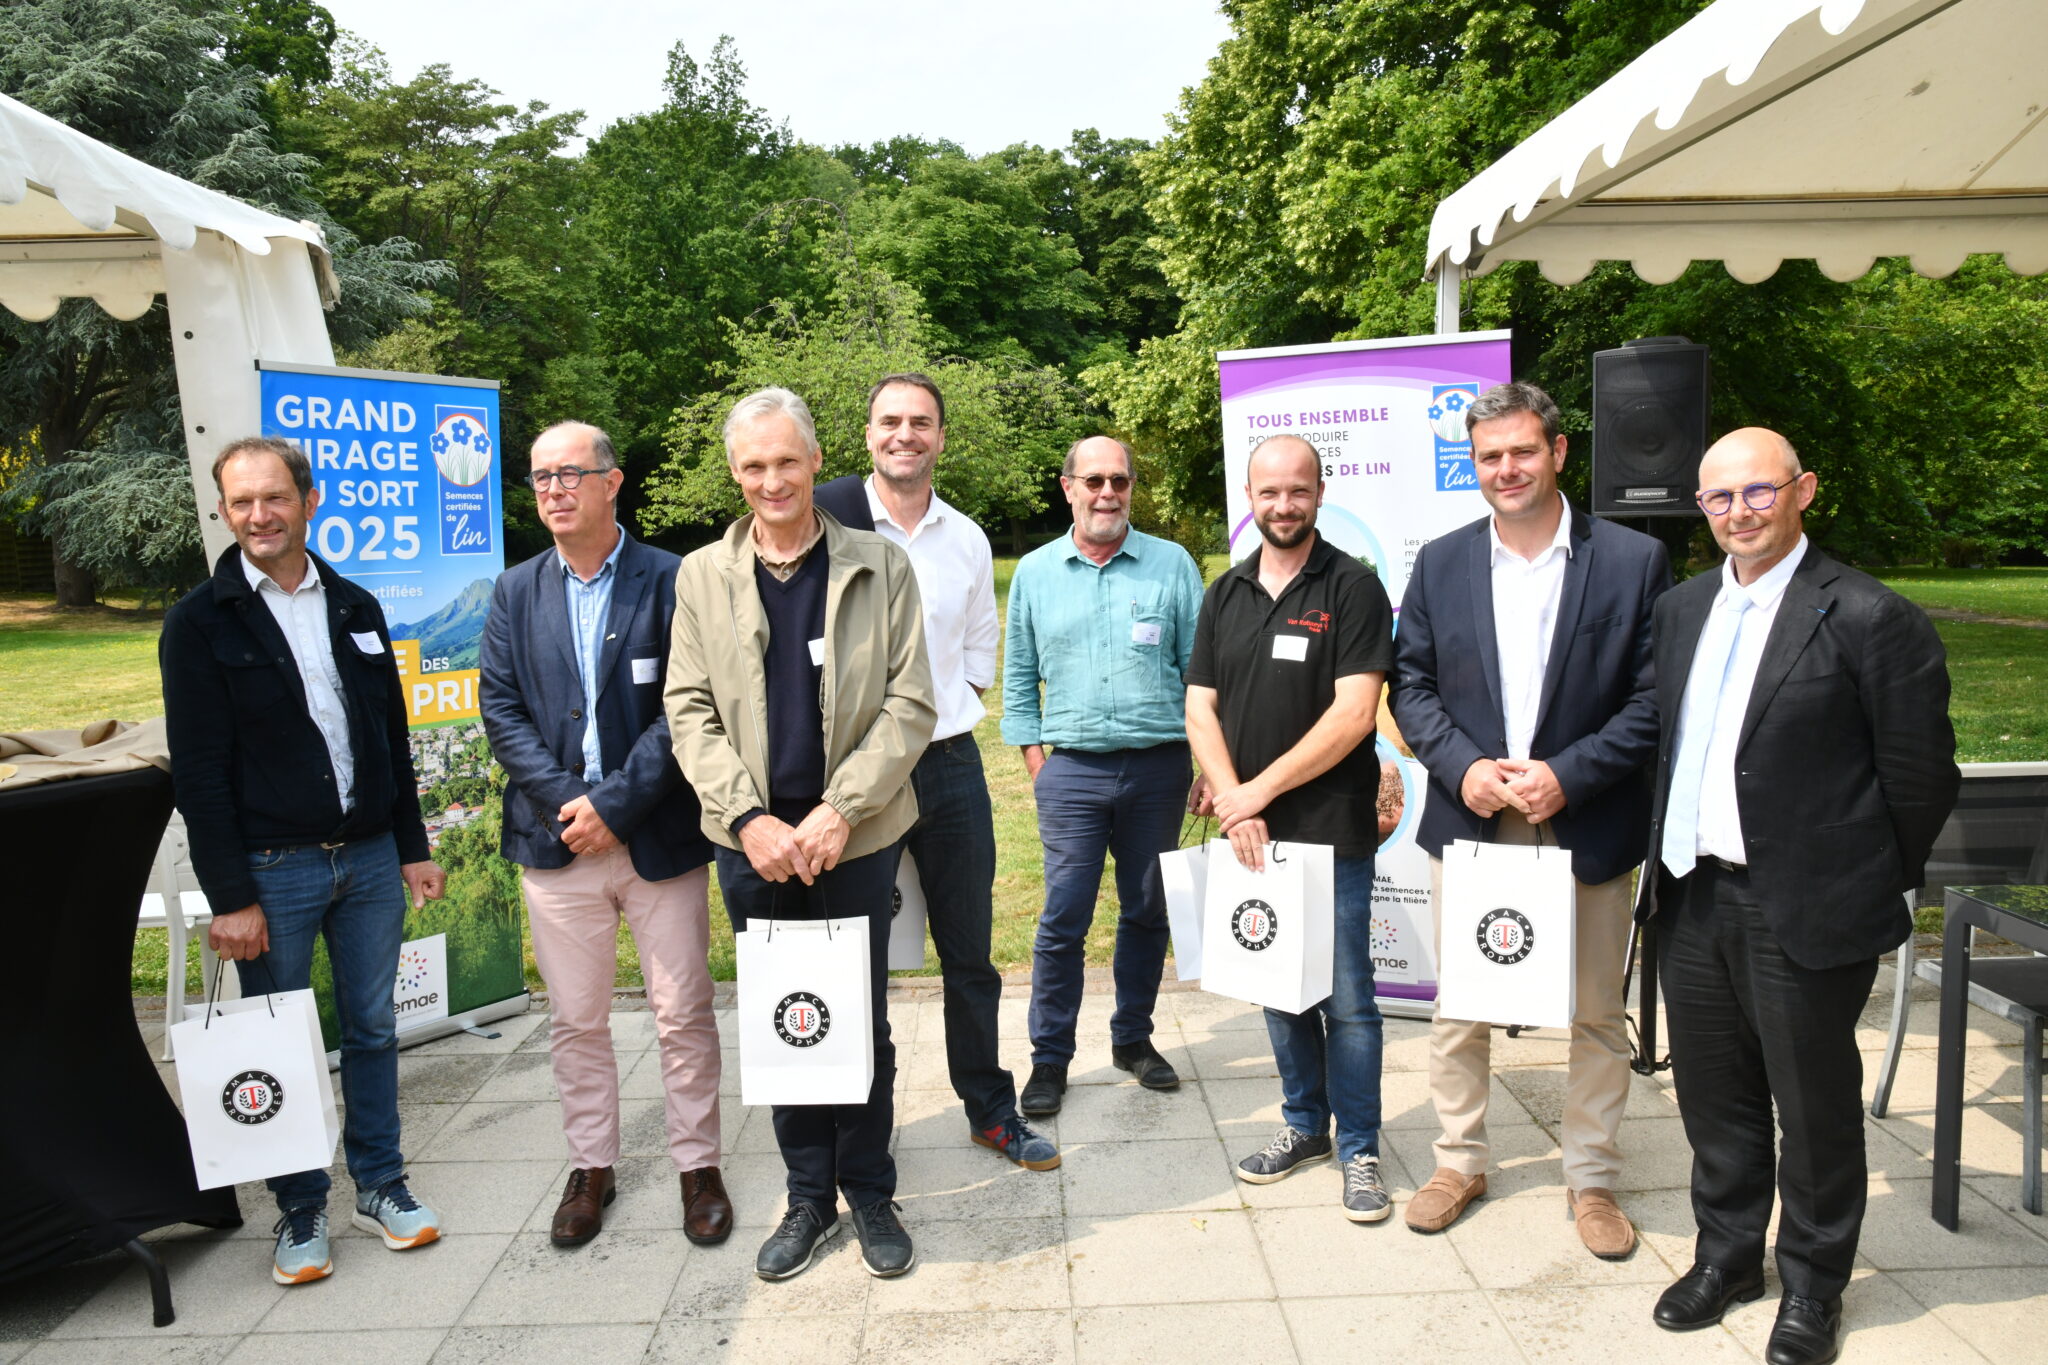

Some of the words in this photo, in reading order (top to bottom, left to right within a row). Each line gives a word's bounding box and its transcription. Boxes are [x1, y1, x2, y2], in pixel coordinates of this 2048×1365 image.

[275, 394, 417, 433] GRAND
[1247, 413, 1293, 428] TOUS
[1299, 407, 1389, 426] ENSEMBLE
[1340, 464, 1359, 476] DE
[1366, 462, 1391, 475] LIN
[1444, 461, 1477, 488] lin
[338, 480, 419, 507] SORT
[445, 491, 484, 500] Semences
[445, 502, 482, 511] certifiées
[446, 513, 457, 522] de
[305, 515, 421, 563] 025
[452, 513, 487, 550] lin
[1404, 538, 1420, 546] Les
[422, 657, 450, 672] DES
[412, 677, 480, 716] PRI
[1374, 876, 1394, 884] MAE,
[1380, 886, 1425, 895] semences
[1243, 902, 1272, 915] MAC
[1403, 896, 1428, 905] filière
[1247, 913, 1265, 937] T
[1487, 910, 1524, 922] MAC
[1232, 919, 1277, 950] TROPHEES
[1495, 924, 1516, 949] T
[1478, 933, 1534, 964] TROPHEES
[1372, 957, 1409, 970] mae
[393, 992, 439, 1015] emae
[783, 993, 819, 1006] MAC
[791, 1008, 813, 1032] T
[775, 1017, 830, 1047] TROPHEES
[231, 1072, 269, 1088] MAC
[223, 1090, 282, 1123] TROPHEES
[239, 1085, 264, 1110] T
